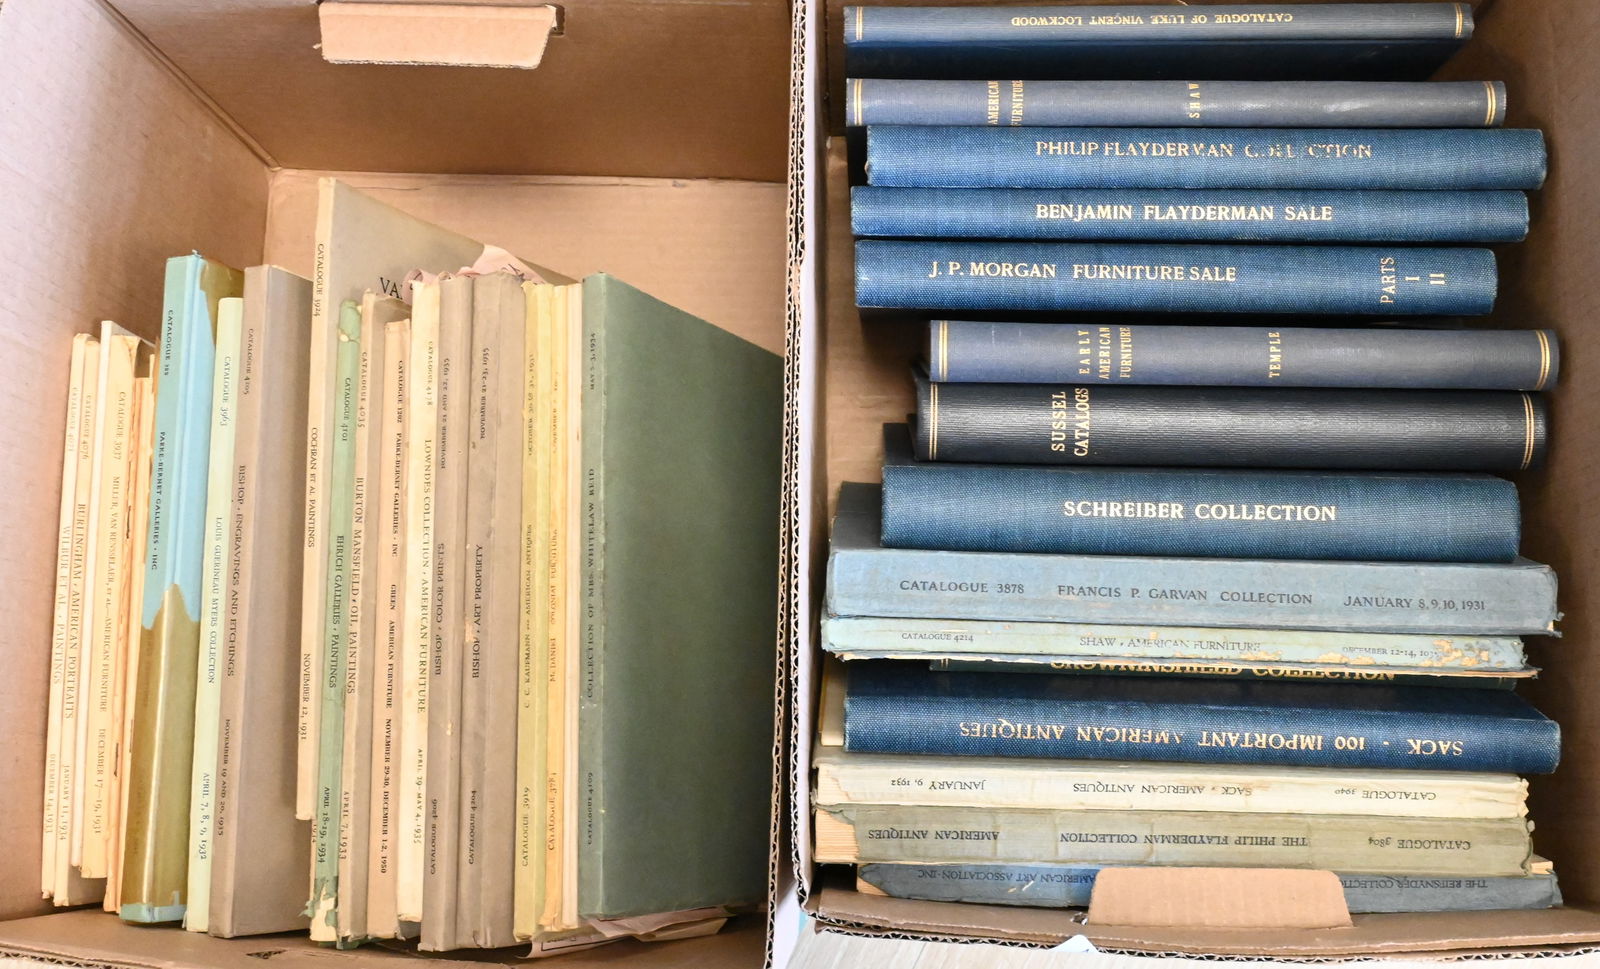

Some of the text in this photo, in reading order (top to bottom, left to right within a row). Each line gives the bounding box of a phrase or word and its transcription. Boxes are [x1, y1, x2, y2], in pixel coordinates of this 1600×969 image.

[1011, 13, 1293, 26] CATALOGUE OF LUKE VINCENT LOCKWOOD
[1189, 83, 1200, 118] SHAW
[1036, 140, 1100, 155] PHILIP
[1036, 204, 1333, 221] BENJAMIN FLAYDERMAN SALE
[928, 261, 1236, 282] J. P. MORGAN FURNITURE SALE
[1380, 257, 1396, 303] PARTS
[1429, 273, 1445, 285] II
[165, 310, 174, 360] CATALOGUE
[244, 328, 254, 373] CATALOGUE
[1078, 330, 1091, 374] EARLY
[1098, 327, 1111, 380] AMERICAN
[1119, 327, 1133, 378] FURNITURE
[1268, 332, 1282, 378] TEMPLE
[396, 360, 404, 404] CATALOGUE
[1050, 391, 1067, 452] SUSSEL
[1074, 387, 1090, 457] CATALOGS
[155, 432, 166, 496] PARKE-BERNET
[302, 243, 325, 702] CATALOGUE 3924 COCHRAN ET AL PAINTINGS NOVEMBER
[393, 433, 403, 490] PARKE-BERNET
[422, 439, 432, 493] LOWNDES
[236, 465, 246, 504] BISHOP
[152, 499, 162, 543] GALLERIES
[392, 493, 400, 534] GALLERIES
[421, 496, 431, 567] COLLECTION
[1063, 501, 1336, 521] SCHREIBER COLLECTION
[231, 514, 244, 585] ENGRAVINGS
[323, 378, 351, 808] CATALOGUE EHRICH GALLERIES PAINTINGS APRIL
[342, 352, 368, 819] CATALOGUE BURTON MANSFIELD PAINTINGS APRIL
[473, 544, 483, 600] PROPERTY
[53, 526, 71, 684] WILBUR ET PAINTINGS
[92, 392, 126, 834] CATALOGUE MILLER, VAN FURNITURE DECEMBER 1931
[199, 356, 231, 860] CATALOGUE 3963 LOUIS GUERINEAU MYERS COLLECTION APRIL 1932
[230, 589, 239, 615] AND
[389, 584, 397, 610] GREEN
[419, 579, 429, 639] AMERICAN
[473, 603, 482, 625] ART
[587, 604, 594, 618] OF
[899, 580, 1412, 609] CATALOGUE 3878 FRANCIS P. GARVAN COLLECTION JANUARY
[62, 503, 86, 800] BURLINGHAM AMERICAN PORTRAITS JANUARY
[227, 619, 238, 677] ETCHINGS
[387, 620, 396, 660] AMERICAN
[429, 426, 448, 875] CATALOGUE BISHOP COLOR PRINTS NOVEMBER
[471, 637, 481, 678] BISHOP
[586, 624, 595, 698] COLLECTION
[902, 632, 951, 641] CATALOGUE
[953, 634, 974, 643] 4214
[1080, 636, 1115, 648] SHAW
[385, 663, 394, 708] FURNITURE
[417, 644, 428, 713] FURNITURE
[521, 570, 533, 867] CATALOGUE KAUFMANN AMERICAN
[959, 719, 1064, 739] ANTIQUES
[1200, 731, 1324, 750] IMPORTANT
[223, 719, 232, 765] NOVEMBER
[384, 719, 393, 763] NOVEMBER
[1333, 735, 1366, 751] 100
[1407, 738, 1463, 755] SACK
[891, 778, 910, 787] 1932
[929, 779, 986, 791] JANUARY
[1073, 782, 1135, 793] ANTIQUES
[1141, 784, 1206, 795] AMERICAN
[1221, 786, 1252, 797] SACK
[1335, 787, 1357, 796] 3940
[1361, 790, 1437, 801] CATALOGUE
[381, 791, 390, 835] DECEMBER
[468, 814, 476, 864] CATALOGUE
[868, 828, 1471, 850] CATALOGUE 3804 THE PHILIP FLAYDERMAN COLLECTION AMERICAN ANTIQUES
[942, 870, 1014, 882] ASSOCIATION
[1015, 873, 1037, 882] ART
[1040, 874, 1095, 883] AMERICAN
[1465, 879, 1488, 889] THE
